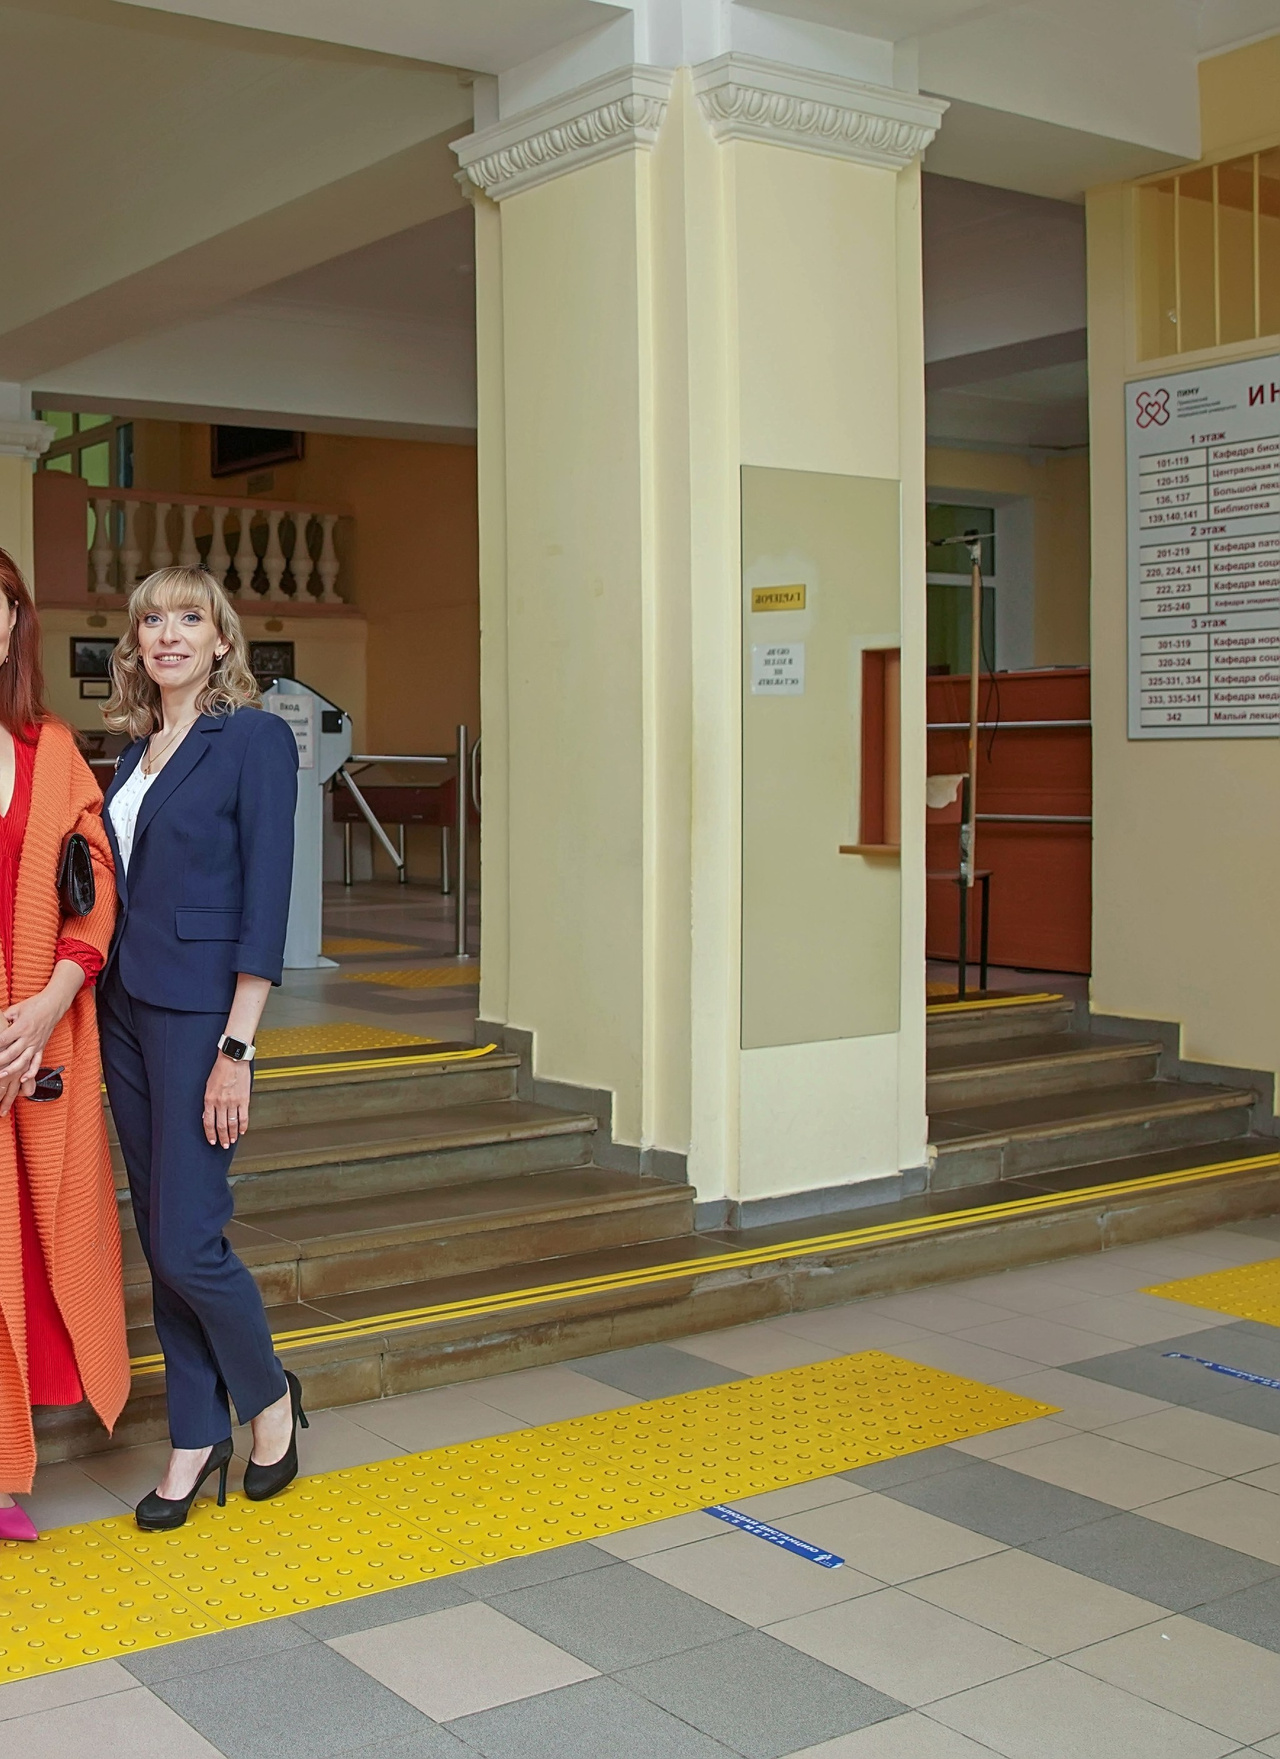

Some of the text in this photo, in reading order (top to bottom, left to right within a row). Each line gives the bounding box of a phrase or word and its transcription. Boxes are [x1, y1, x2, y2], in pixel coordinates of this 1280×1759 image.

[1190, 432, 1226, 444] 1 этаж
[1212, 446, 1254, 460] Кафедра
[1156, 456, 1189, 468] 101-119
[1212, 462, 1272, 478] Центральная
[1156, 475, 1190, 487] 120-135
[1212, 483, 1257, 496] Большой
[1176, 492, 1191, 503] 137
[1214, 502, 1270, 515] Библиотека
[1190, 525, 1227, 536] 2 этаж
[1214, 542, 1256, 552] Кафедра
[1186, 564, 1201, 574] 241
[1214, 561, 1256, 572] Кафедра
[1214, 580, 1256, 592] Кафедра
[1191, 618, 1228, 629] 3 этаж
[1214, 638, 1256, 648] Кафедра
[1214, 656, 1256, 666] Кафедра
[1214, 676, 1256, 686] Кафедра
[1214, 693, 1256, 702] Кафедра
[1166, 712, 1182, 722] 342
[1214, 710, 1247, 720] Малый
[743, 1524, 786, 1546] МЕТРА
[756, 1524, 820, 1554] ДИСТАНЦИЮ
